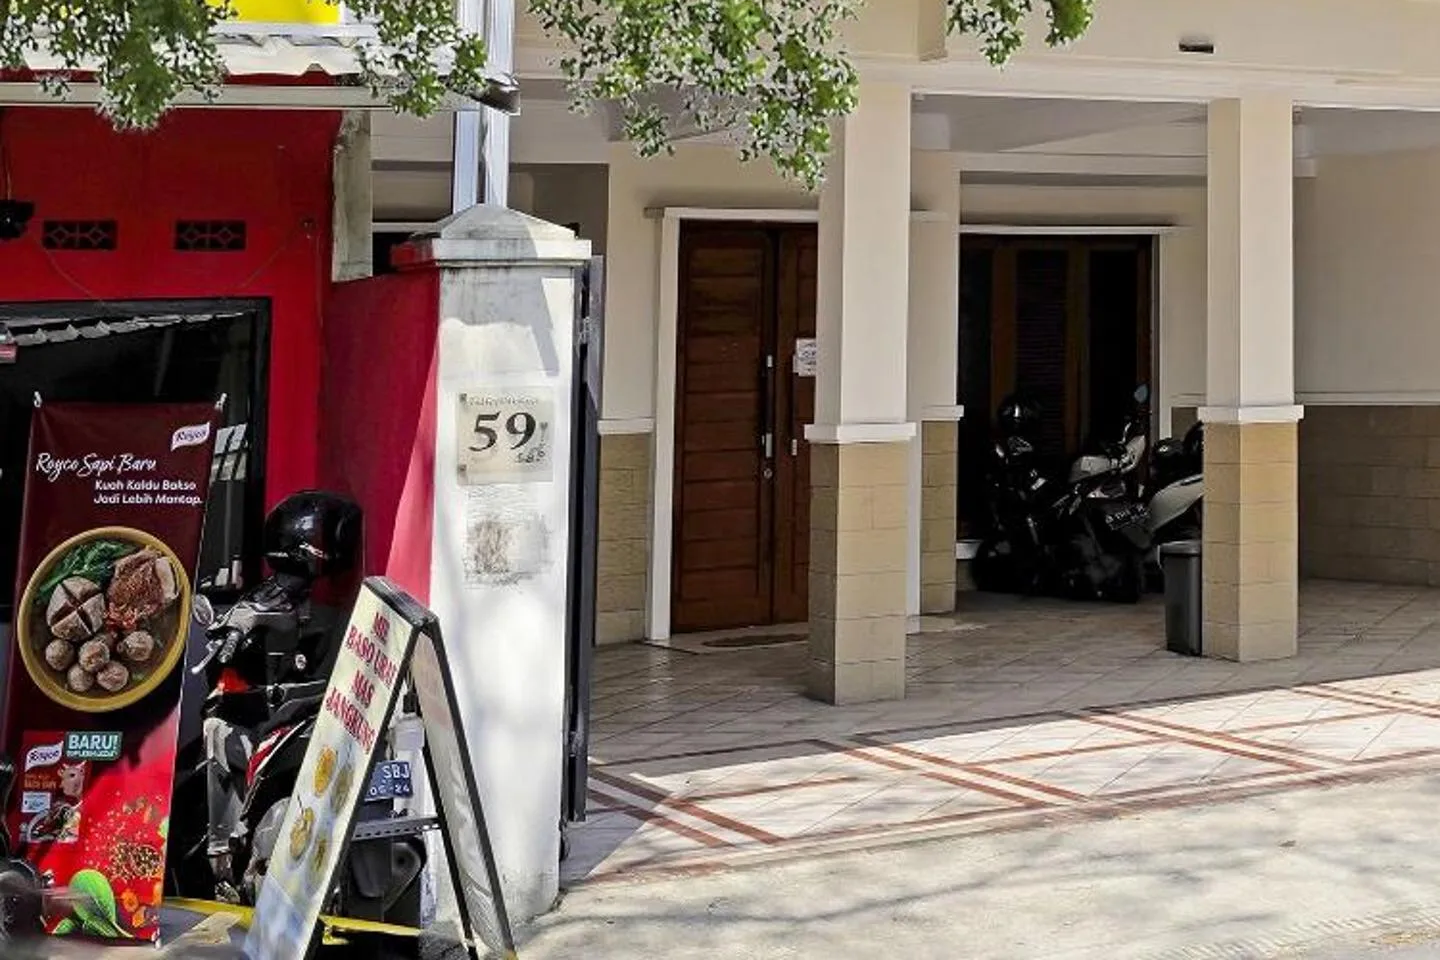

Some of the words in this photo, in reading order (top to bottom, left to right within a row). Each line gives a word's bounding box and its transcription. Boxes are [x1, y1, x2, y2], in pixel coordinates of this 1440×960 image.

[468, 410, 537, 452] 59
[36, 452, 79, 483] Royco
[76, 452, 116, 477] Sapi
[116, 452, 157, 475] Baru
[95, 480, 124, 491] Kuah
[126, 480, 160, 491] Kaldu
[162, 480, 197, 491] Bakso
[93, 493, 121, 505] Jadi
[122, 493, 153, 505] Lebih
[154, 495, 204, 507] Mantap.
[68, 734, 119, 750] BARU!
